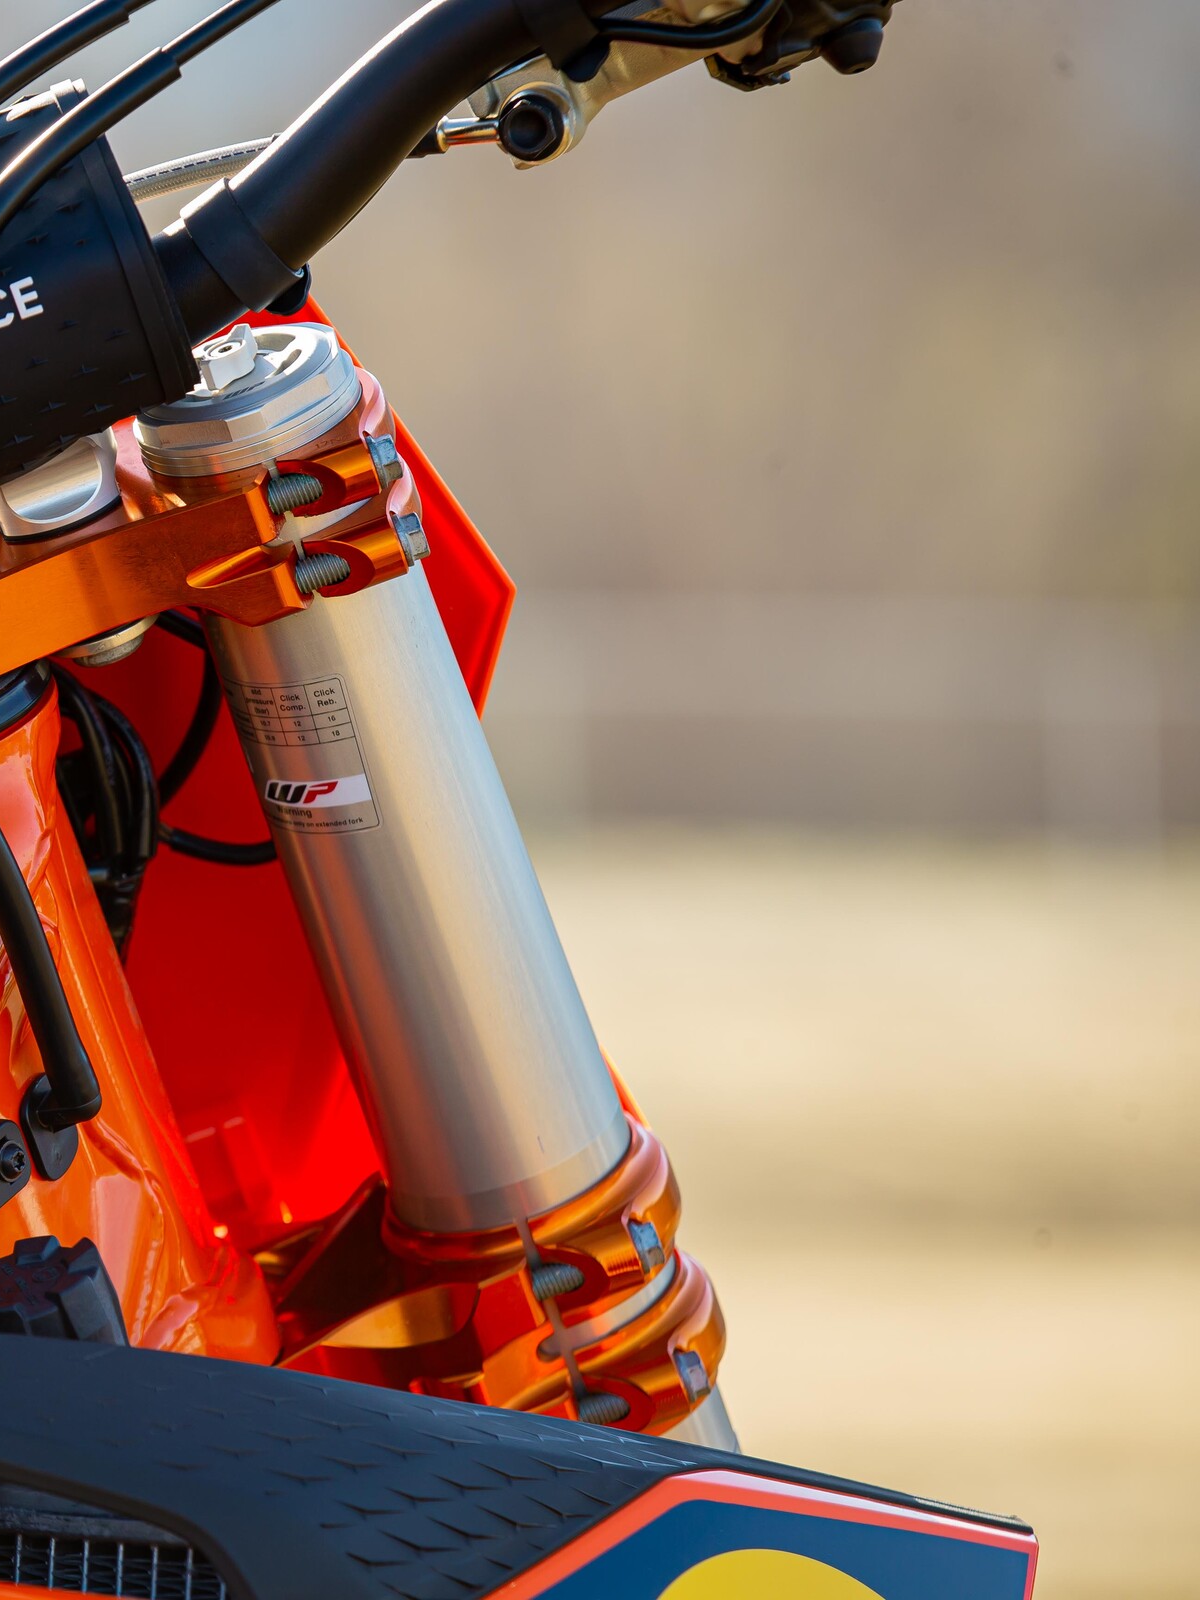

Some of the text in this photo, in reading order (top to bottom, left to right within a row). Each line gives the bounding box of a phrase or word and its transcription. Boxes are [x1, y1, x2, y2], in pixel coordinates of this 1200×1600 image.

[313, 688, 335, 697] Click
[280, 694, 300, 702] Click
[317, 698, 337, 707] Reb.
[280, 704, 306, 713] Comp.
[267, 781, 338, 804] WP
[315, 819, 347, 827] extended
[349, 817, 363, 825] fork
